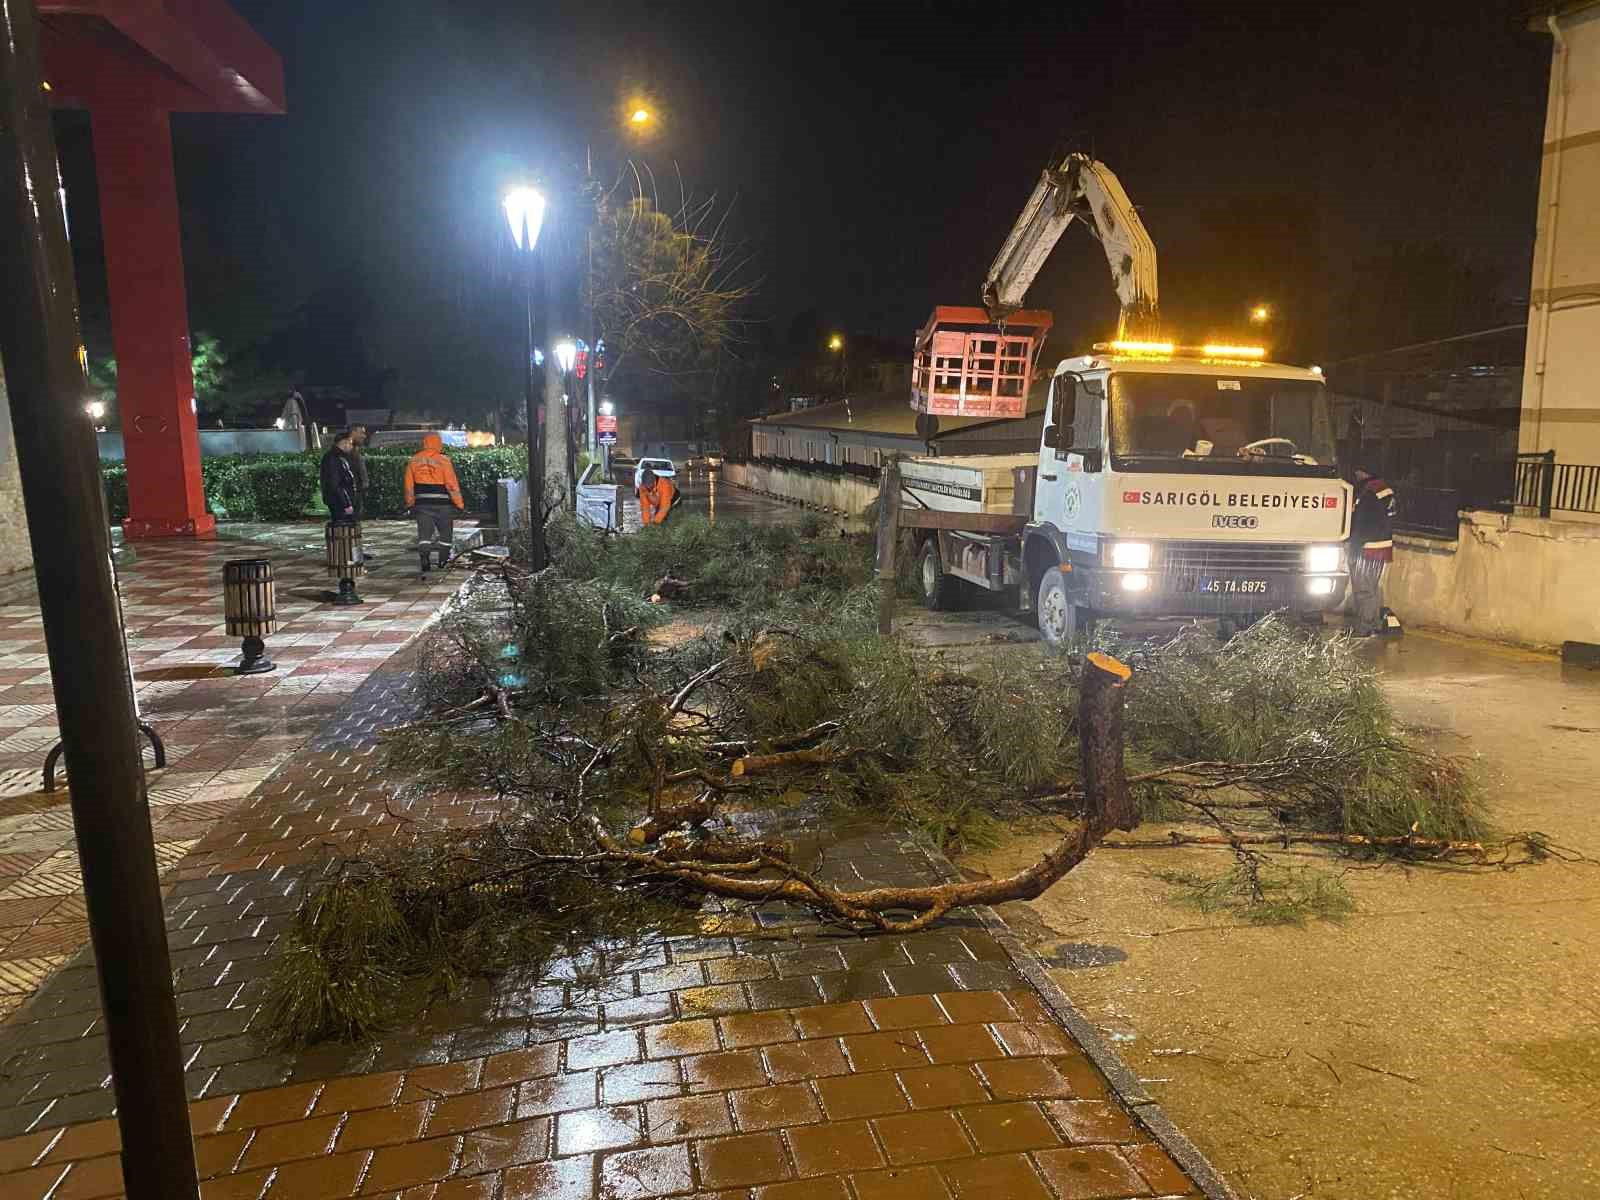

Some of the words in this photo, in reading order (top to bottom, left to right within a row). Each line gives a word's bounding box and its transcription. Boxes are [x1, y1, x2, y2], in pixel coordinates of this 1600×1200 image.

[1141, 490, 1221, 506] SARIGÖL
[1228, 492, 1325, 508] BELEDİYESİ
[1212, 514, 1258, 529] IVECO
[1207, 580, 1220, 593] 45
